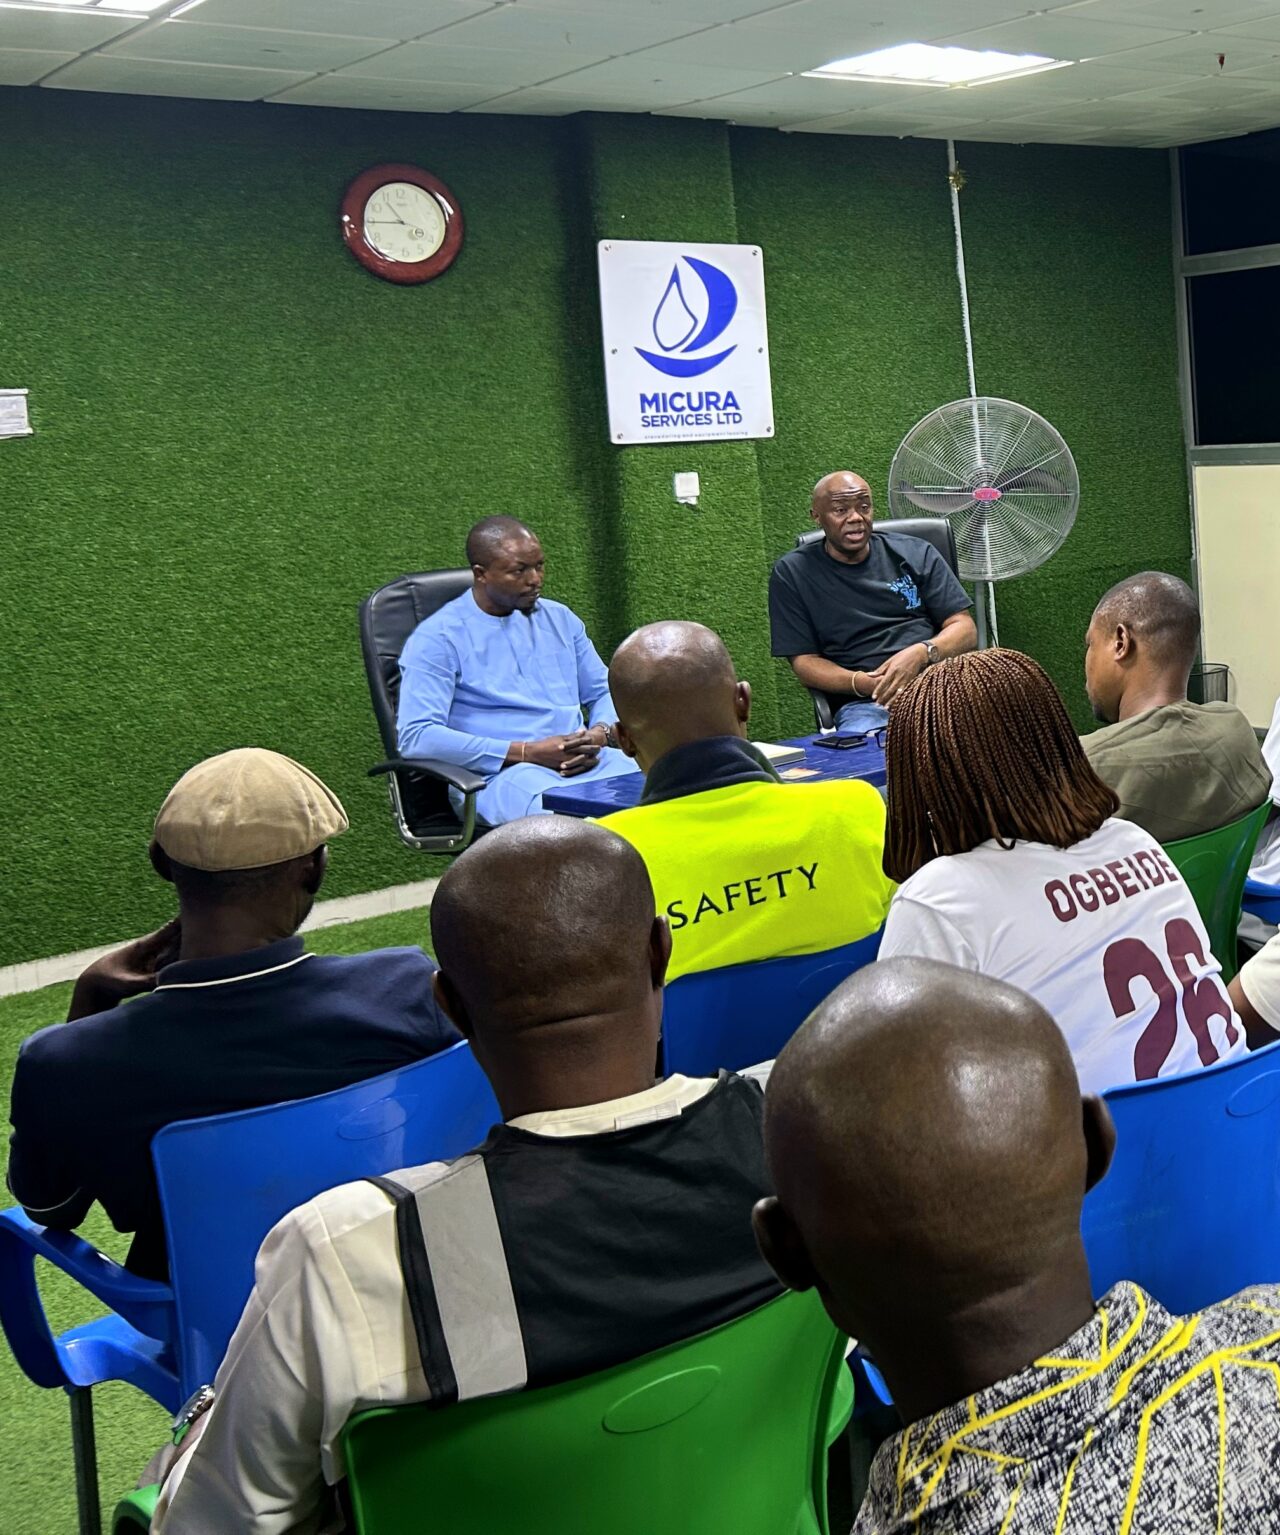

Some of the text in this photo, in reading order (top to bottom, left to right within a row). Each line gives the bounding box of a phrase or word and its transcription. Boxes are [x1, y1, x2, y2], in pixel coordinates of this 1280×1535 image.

[640, 390, 740, 413] MICURA
[641, 412, 743, 427] SERVICES LTD
[667, 863, 818, 929] SAFETY
[1044, 848, 1178, 922] OGBEIDE
[1103, 917, 1239, 1082] 26
